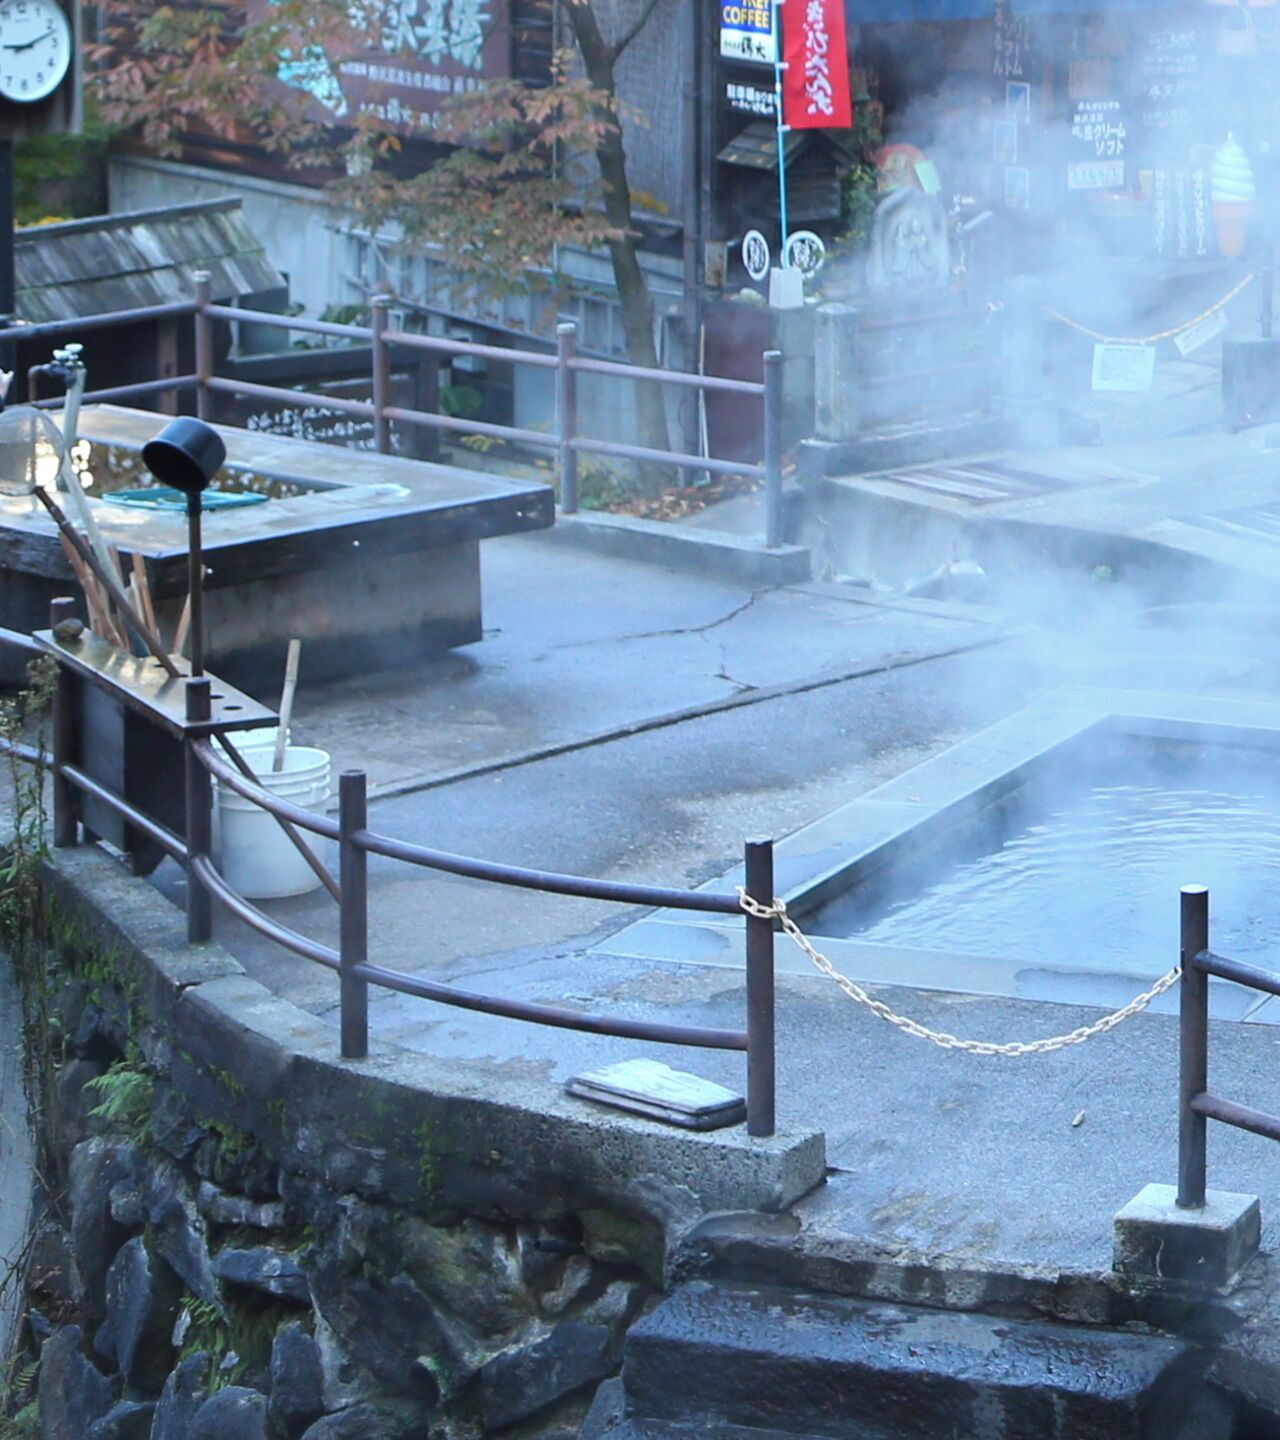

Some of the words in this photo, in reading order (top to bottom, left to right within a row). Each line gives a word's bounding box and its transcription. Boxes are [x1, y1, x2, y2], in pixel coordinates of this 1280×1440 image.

[722, 6, 769, 28] COFFEE
[1095, 139, 1124, 157] ソフト
